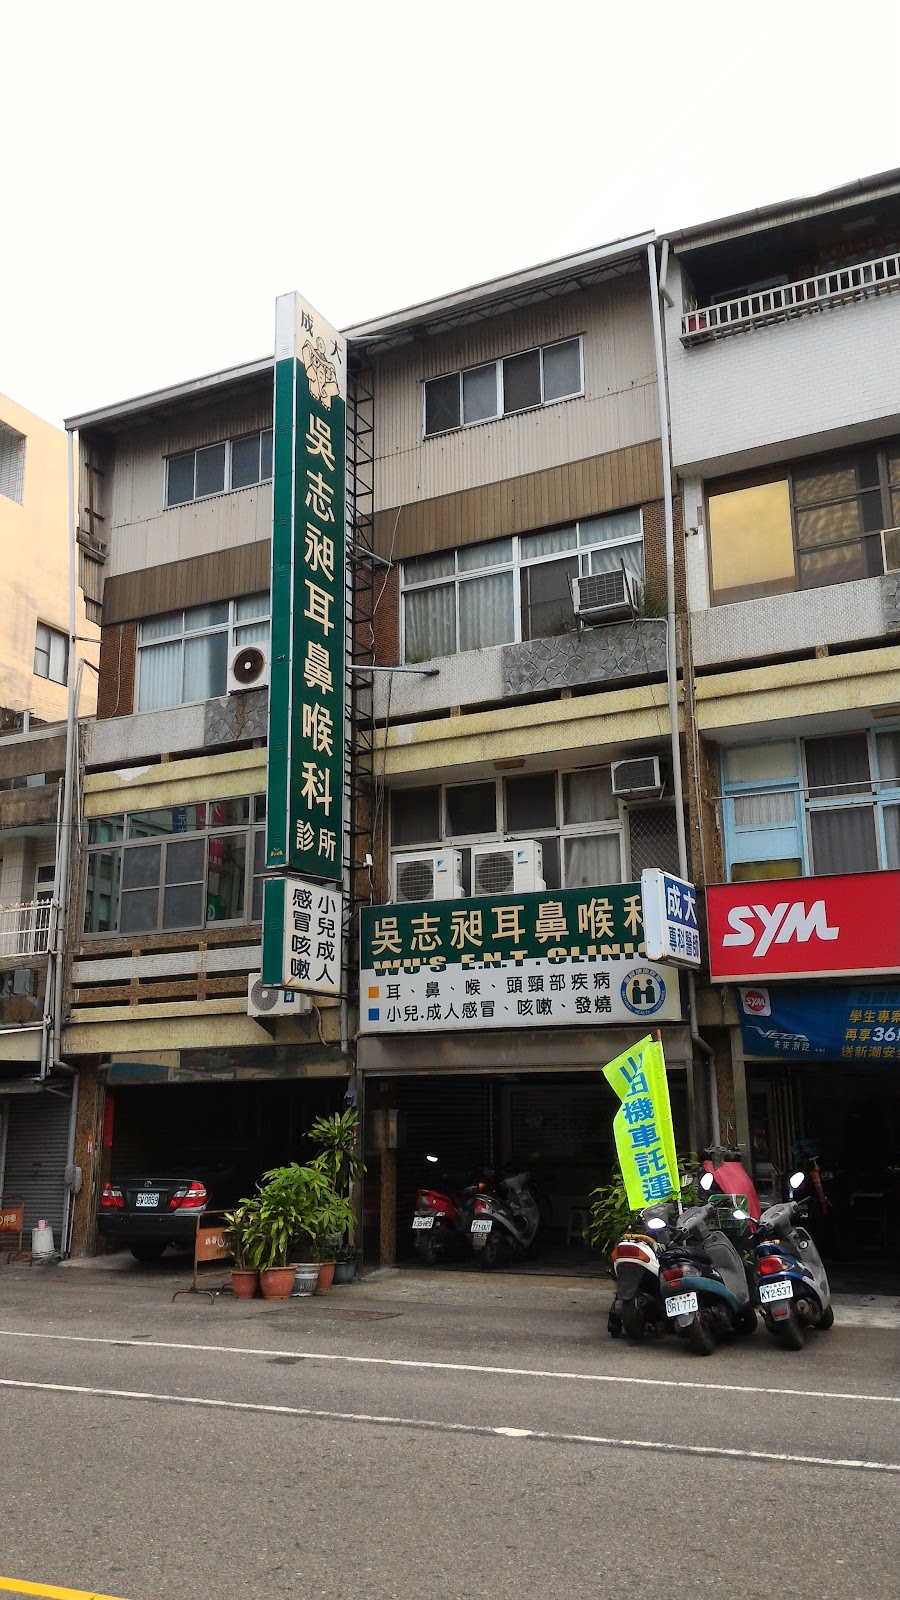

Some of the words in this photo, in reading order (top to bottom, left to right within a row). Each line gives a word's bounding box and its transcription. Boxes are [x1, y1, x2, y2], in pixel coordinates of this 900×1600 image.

[296, 819, 336, 862] 診所
[667, 884, 697, 925] 成大
[290, 888, 313, 981] 感冒咳嗽
[316, 895, 336, 985] 小兒成人
[722, 900, 840, 957] SYM
[373, 955, 447, 977] WU'S
[745, 996, 767, 1008] SYM
[841, 1045, 900, 1058] 送新潮安
